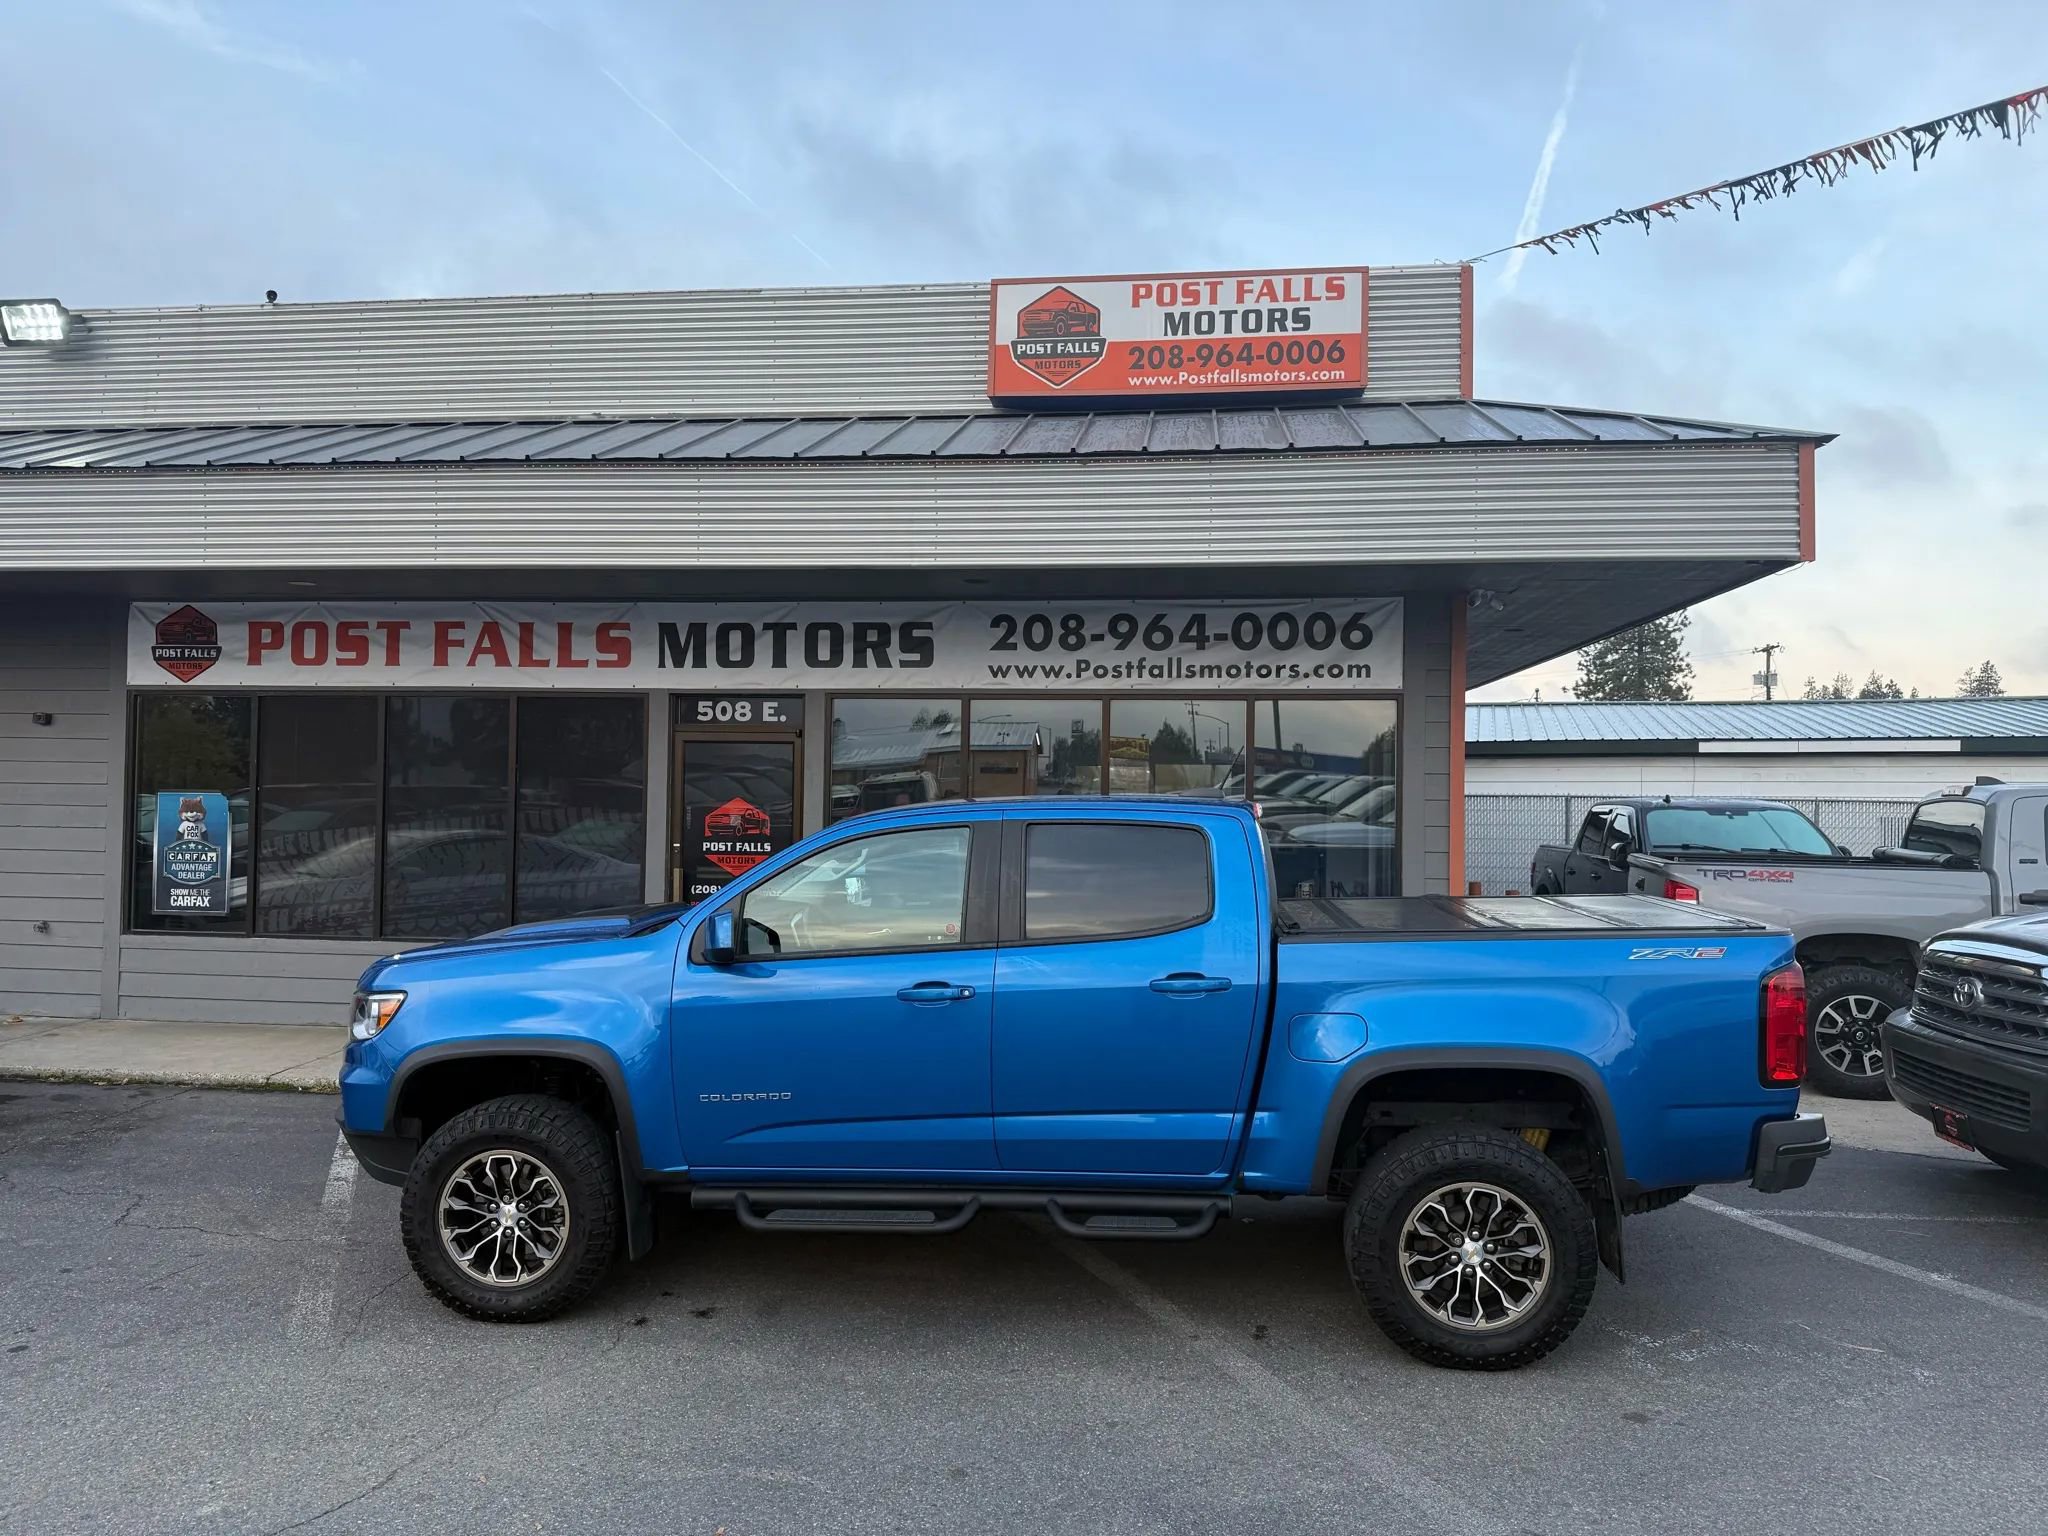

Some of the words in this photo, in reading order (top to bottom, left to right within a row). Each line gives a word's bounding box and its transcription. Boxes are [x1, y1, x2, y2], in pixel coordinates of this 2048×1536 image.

[1131, 281, 1224, 308] POST
[1235, 276, 1345, 305] FALLS
[1163, 307, 1311, 336] MOTORS
[1017, 343, 1053, 355] POST
[1057, 342, 1100, 353] FALLS
[1128, 339, 1345, 370] 208-964-0006
[1034, 360, 1081, 370] MOTORS
[1128, 368, 1345, 386] www.Postfallsmotors.com
[989, 612, 1373, 652] 208-964-0006
[247, 620, 411, 666] POST
[433, 621, 632, 668] FALLS
[657, 622, 934, 668] MOTORS
[156, 648, 182, 658] POST
[184, 648, 217, 658] FALLS
[168, 662, 203, 670] MOTORS
[987, 657, 1372, 680] www.Postfallsmotors.com
[697, 701, 752, 722] 508
[762, 702, 787, 722] E.
[702, 842, 733, 851] POST
[736, 842, 771, 852] FALLS
[168, 853, 216, 862] CARFAX
[718, 856, 756, 865] MOTORS
[171, 863, 212, 871] ADVANTAGE
[1696, 868, 1747, 881] TRD
[170, 896, 211, 906] CARFAX
[1628, 946, 1728, 960] ZR2
[699, 1092, 792, 1101] COLORADO
